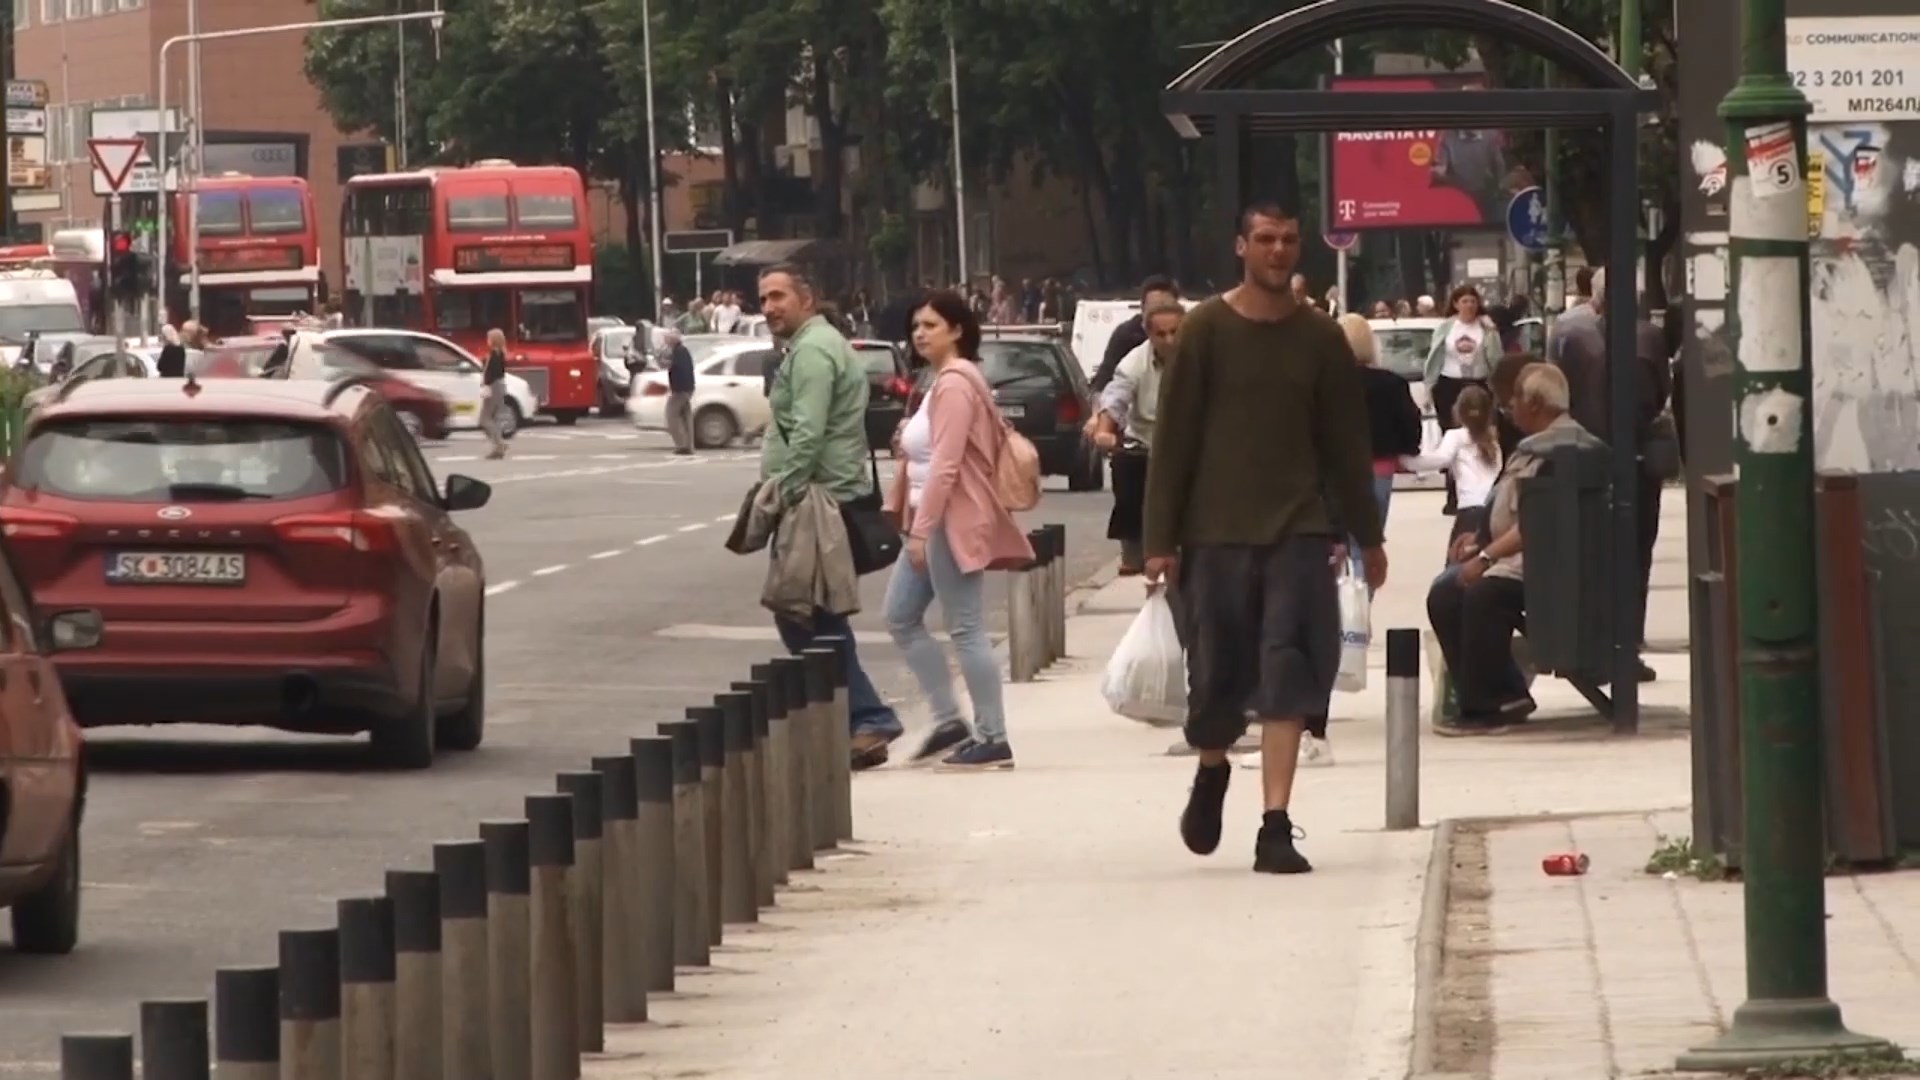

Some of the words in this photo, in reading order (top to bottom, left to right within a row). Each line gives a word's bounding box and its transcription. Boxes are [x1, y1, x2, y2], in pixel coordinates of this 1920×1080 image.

[1814, 71, 1824, 87] 3
[1831, 70, 1863, 87] 201
[1871, 70, 1904, 86] 201
[1777, 164, 1790, 185] 5
[120, 556, 143, 576] SK
